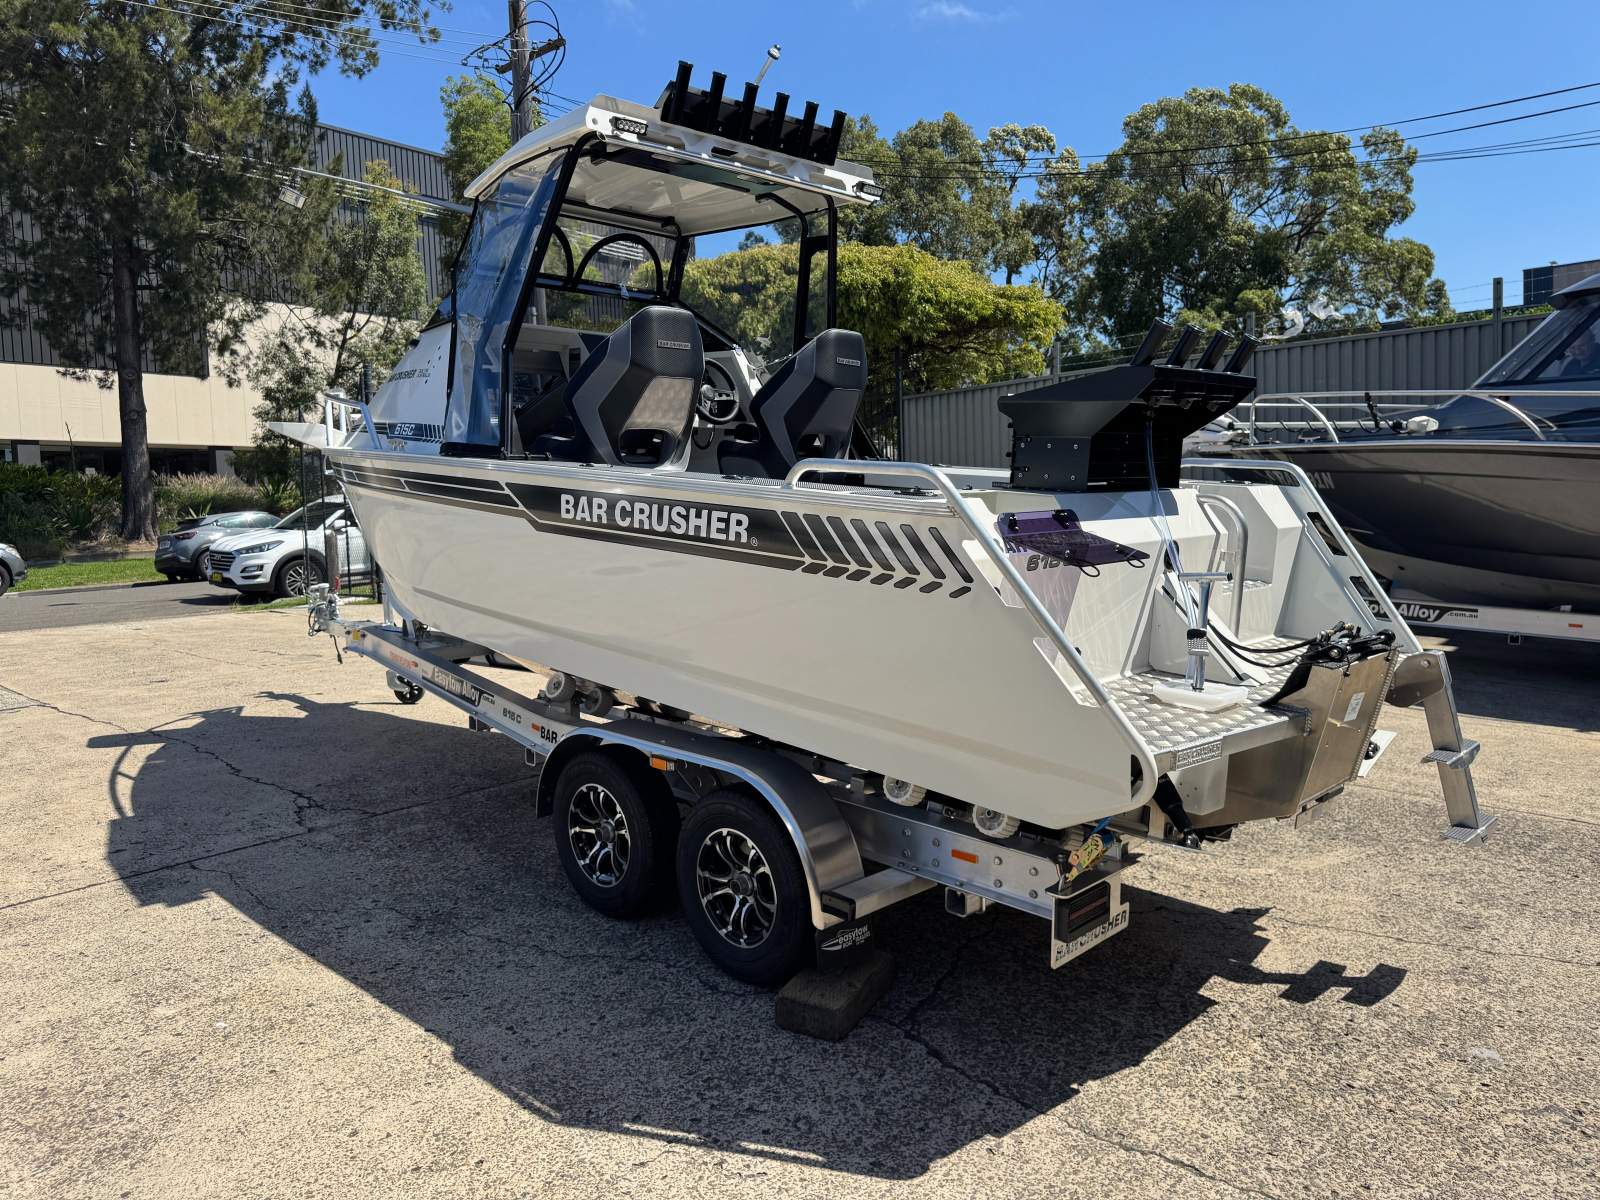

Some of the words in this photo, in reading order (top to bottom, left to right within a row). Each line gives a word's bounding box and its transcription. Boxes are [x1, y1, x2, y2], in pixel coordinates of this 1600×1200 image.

[395, 424, 415, 435] 615C
[560, 493, 608, 524] BAR
[614, 499, 750, 543] CRUSHER
[1398, 603, 1440, 621] Alloy
[541, 726, 558, 744] BAR
